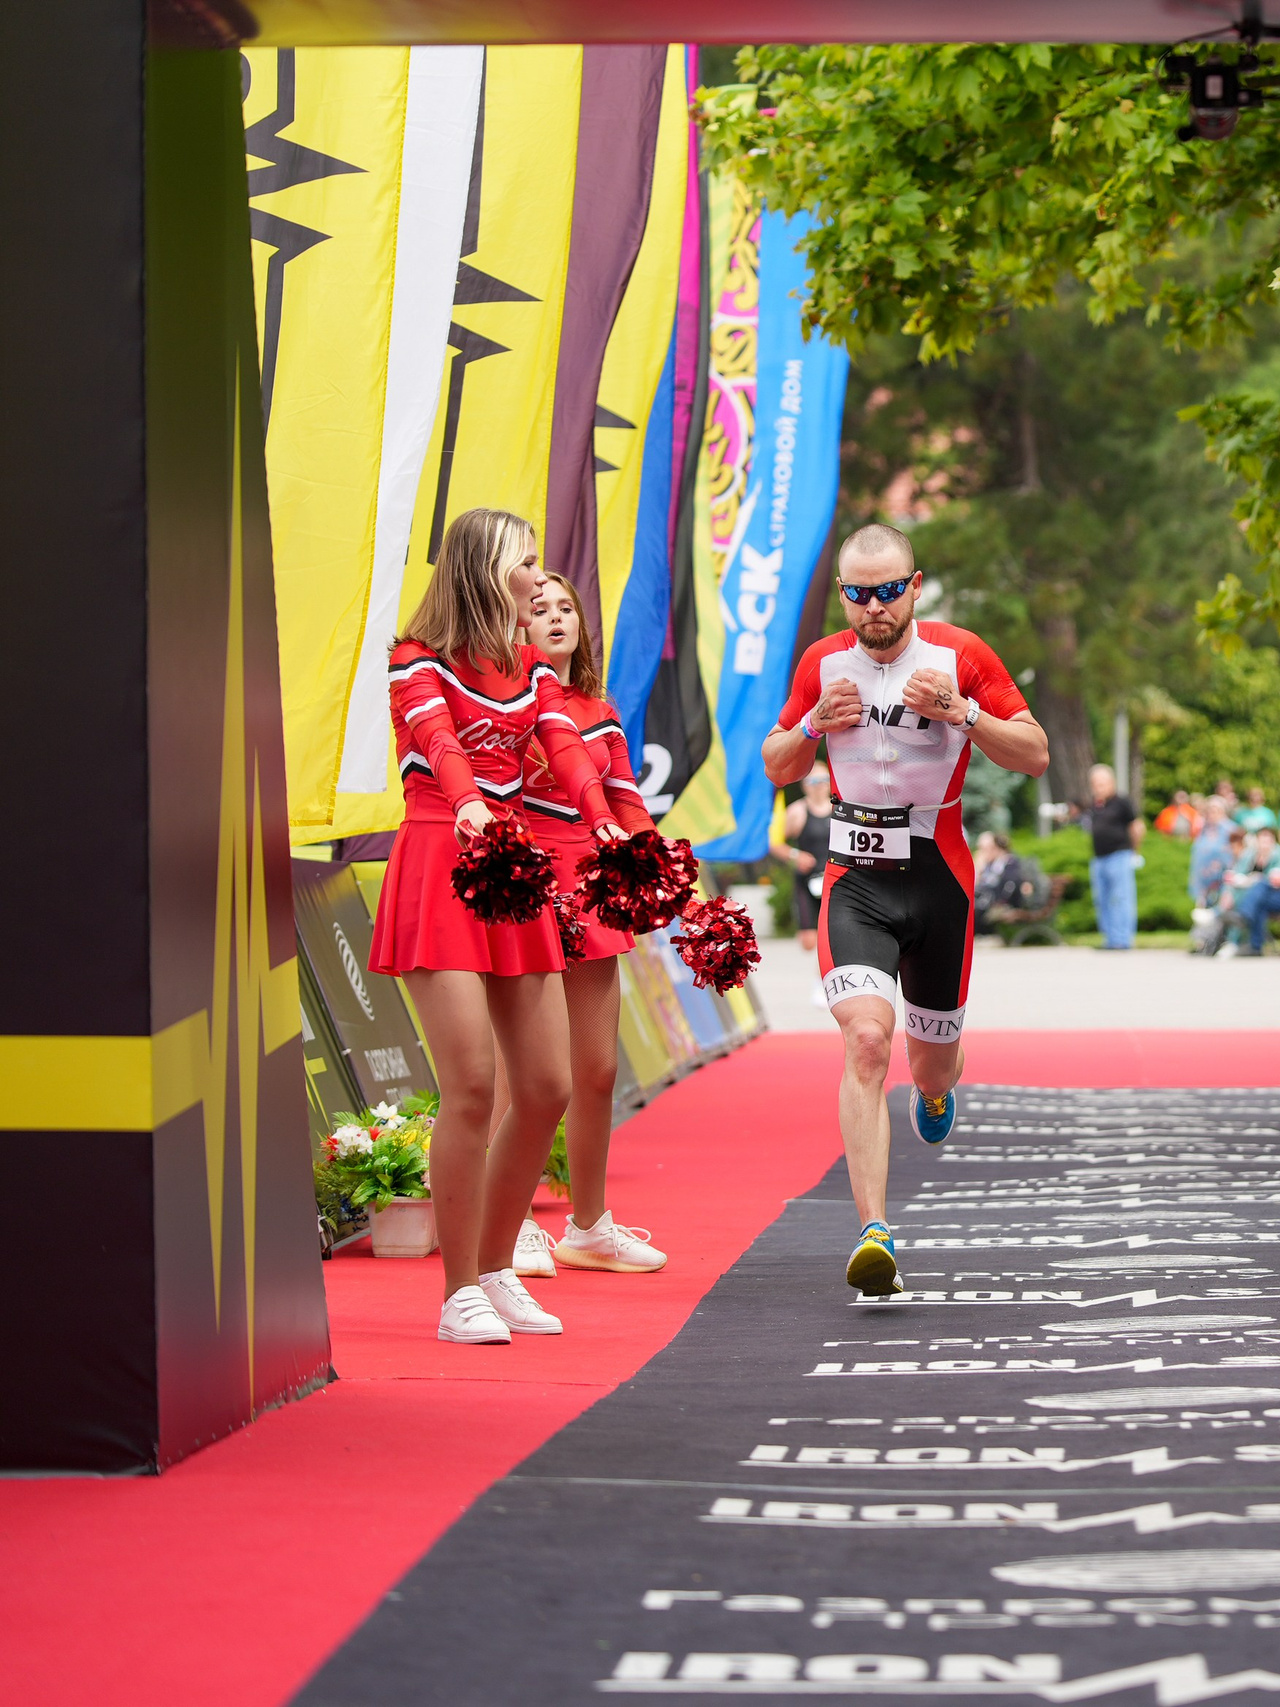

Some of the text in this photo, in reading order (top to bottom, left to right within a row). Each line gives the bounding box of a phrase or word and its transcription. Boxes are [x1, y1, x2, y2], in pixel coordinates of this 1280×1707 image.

[779, 359, 804, 414] ДОМ
[769, 416, 798, 548] СТРАХОВОЙ
[848, 829, 885, 854] 192
[855, 858, 875, 866] YURIY
[812, 1358, 1076, 1374] IRON
[749, 1444, 1066, 1464] IRON
[710, 1497, 1059, 1521] IRON
[612, 1651, 1062, 1683] IRON
